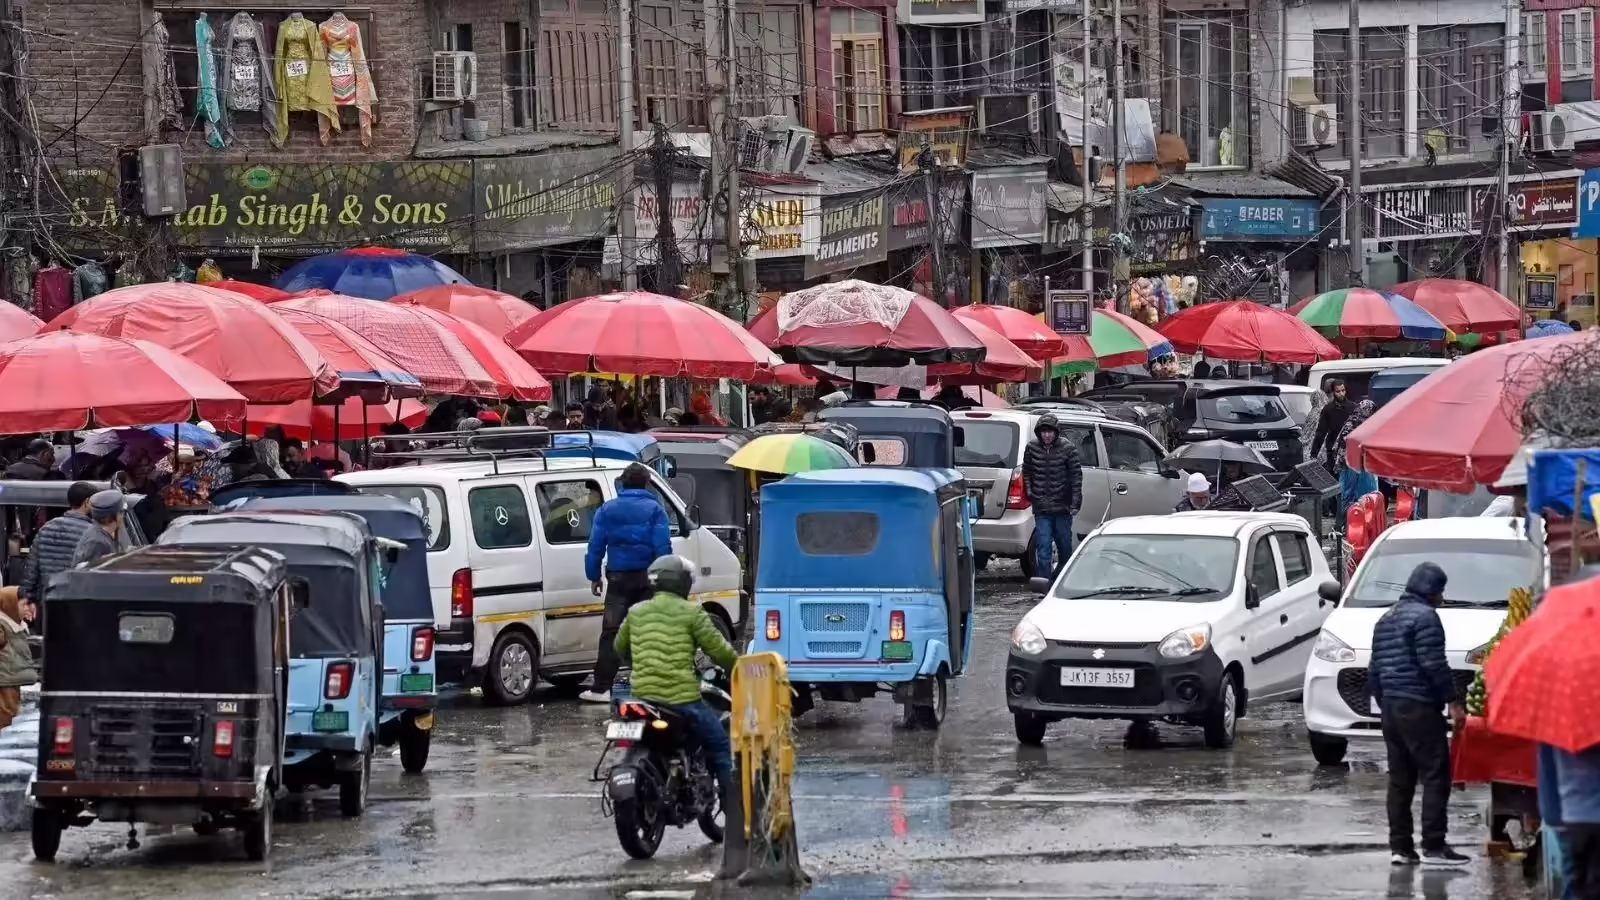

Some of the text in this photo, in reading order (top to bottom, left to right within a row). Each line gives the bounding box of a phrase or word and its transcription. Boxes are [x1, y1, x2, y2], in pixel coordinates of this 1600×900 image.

[236, 193, 329, 234] Singh
[338, 194, 363, 225] &
[372, 194, 448, 224] Sons
[752, 199, 804, 227] SAUDI
[1248, 207, 1284, 221] FABER
[1385, 189, 1430, 219] ELEGANT
[814, 232, 879, 261] ORNAMENTS
[1069, 671, 1130, 684] JK13F 3557
